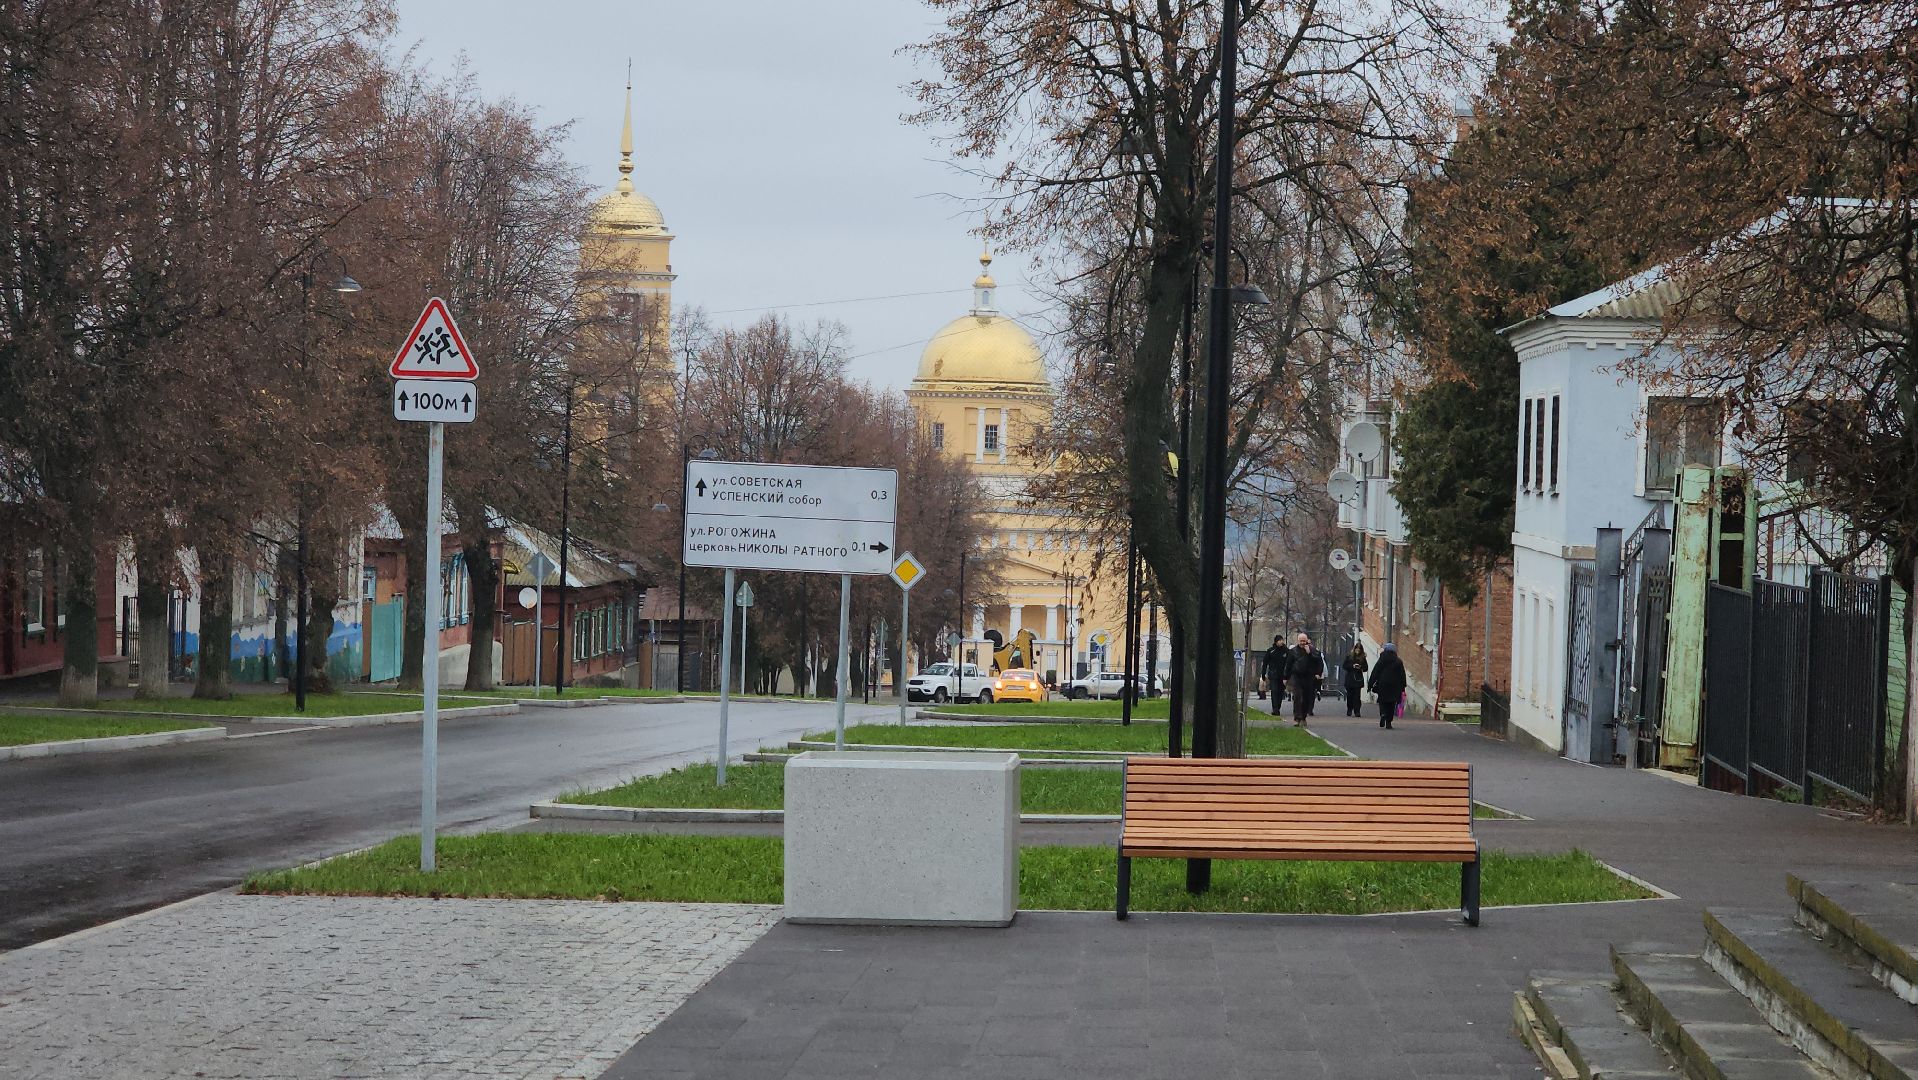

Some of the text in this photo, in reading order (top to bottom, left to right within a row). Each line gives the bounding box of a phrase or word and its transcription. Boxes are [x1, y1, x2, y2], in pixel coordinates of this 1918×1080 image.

[412, 393, 457, 410] 100м
[730, 476, 802, 488] СОВЕТСКАЯ
[712, 491, 822, 507] УСПЕНСКИЙ собор
[708, 526, 776, 539] РОГОЖИНА
[689, 543, 848, 558] церковь НИКОЛЫ РАТНОГО
